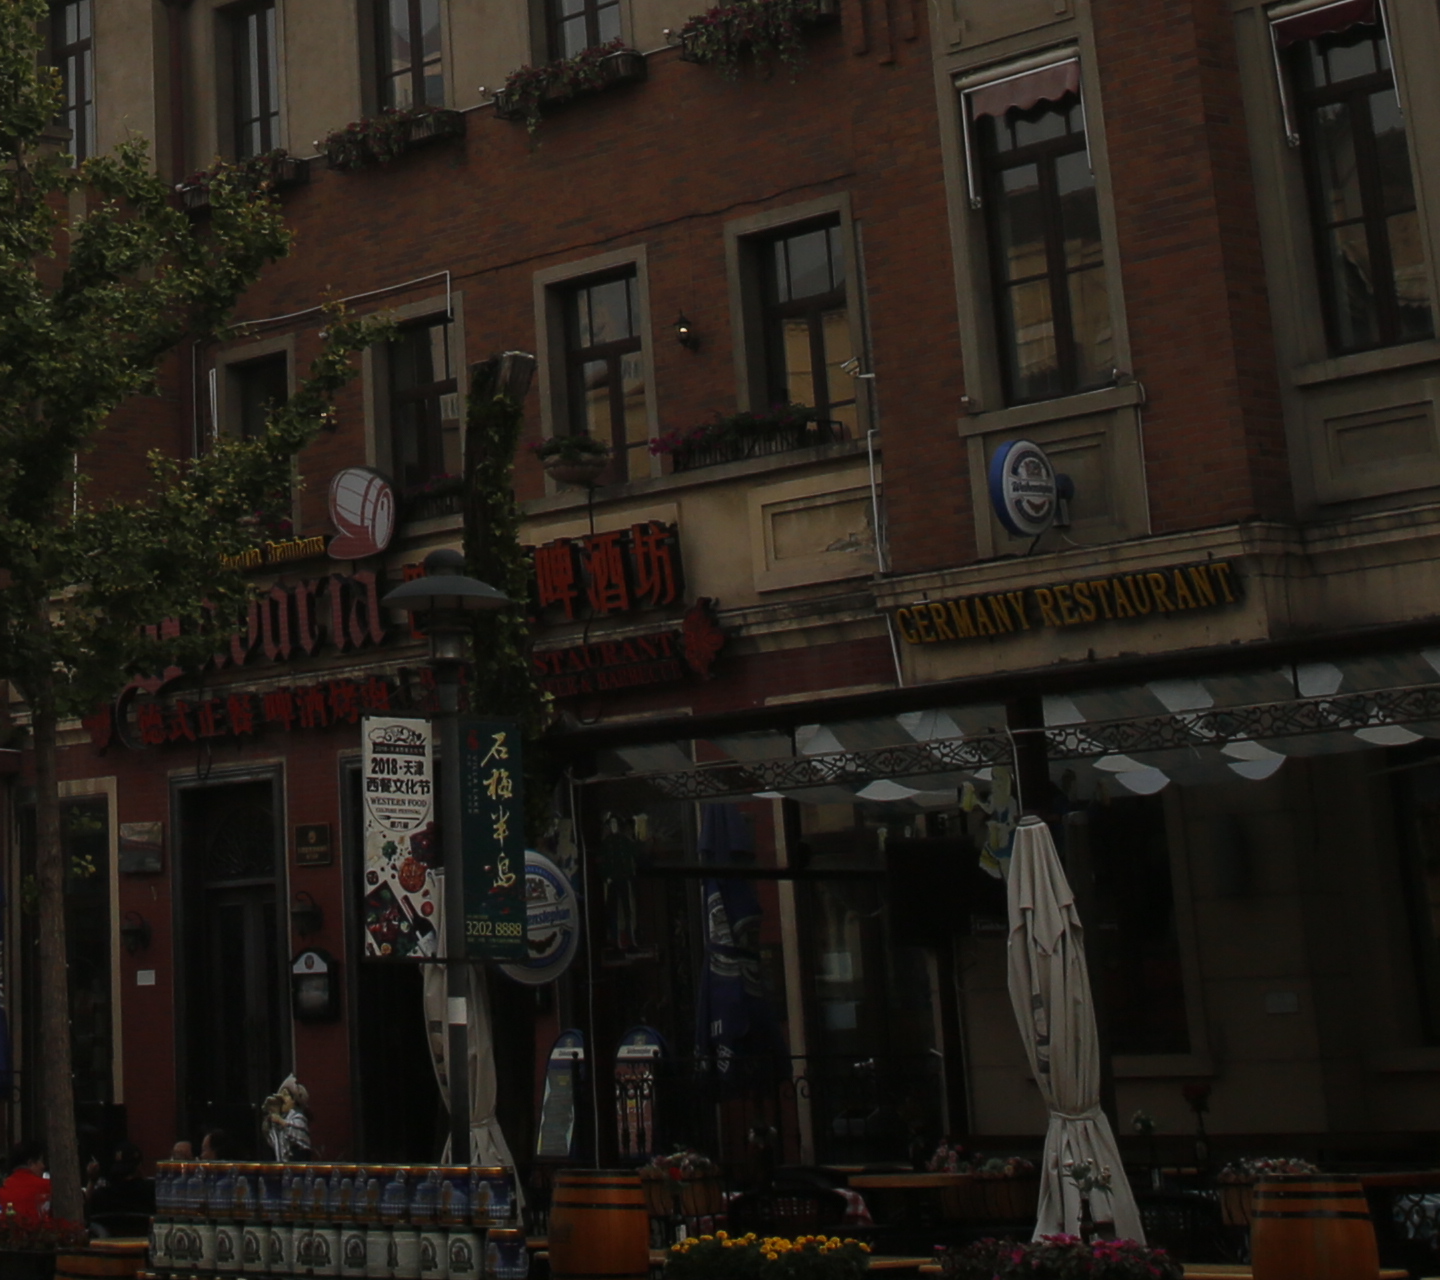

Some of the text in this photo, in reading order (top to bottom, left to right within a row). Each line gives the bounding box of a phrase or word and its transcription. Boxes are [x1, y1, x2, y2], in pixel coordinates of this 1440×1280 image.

[895, 560, 1242, 645] GERMANY RESTAURANT
[366, 777, 431, 795] 西餐文化节
[370, 796, 427, 808] WESTERN FOOD
[465, 921, 523, 937] 3202 8888
